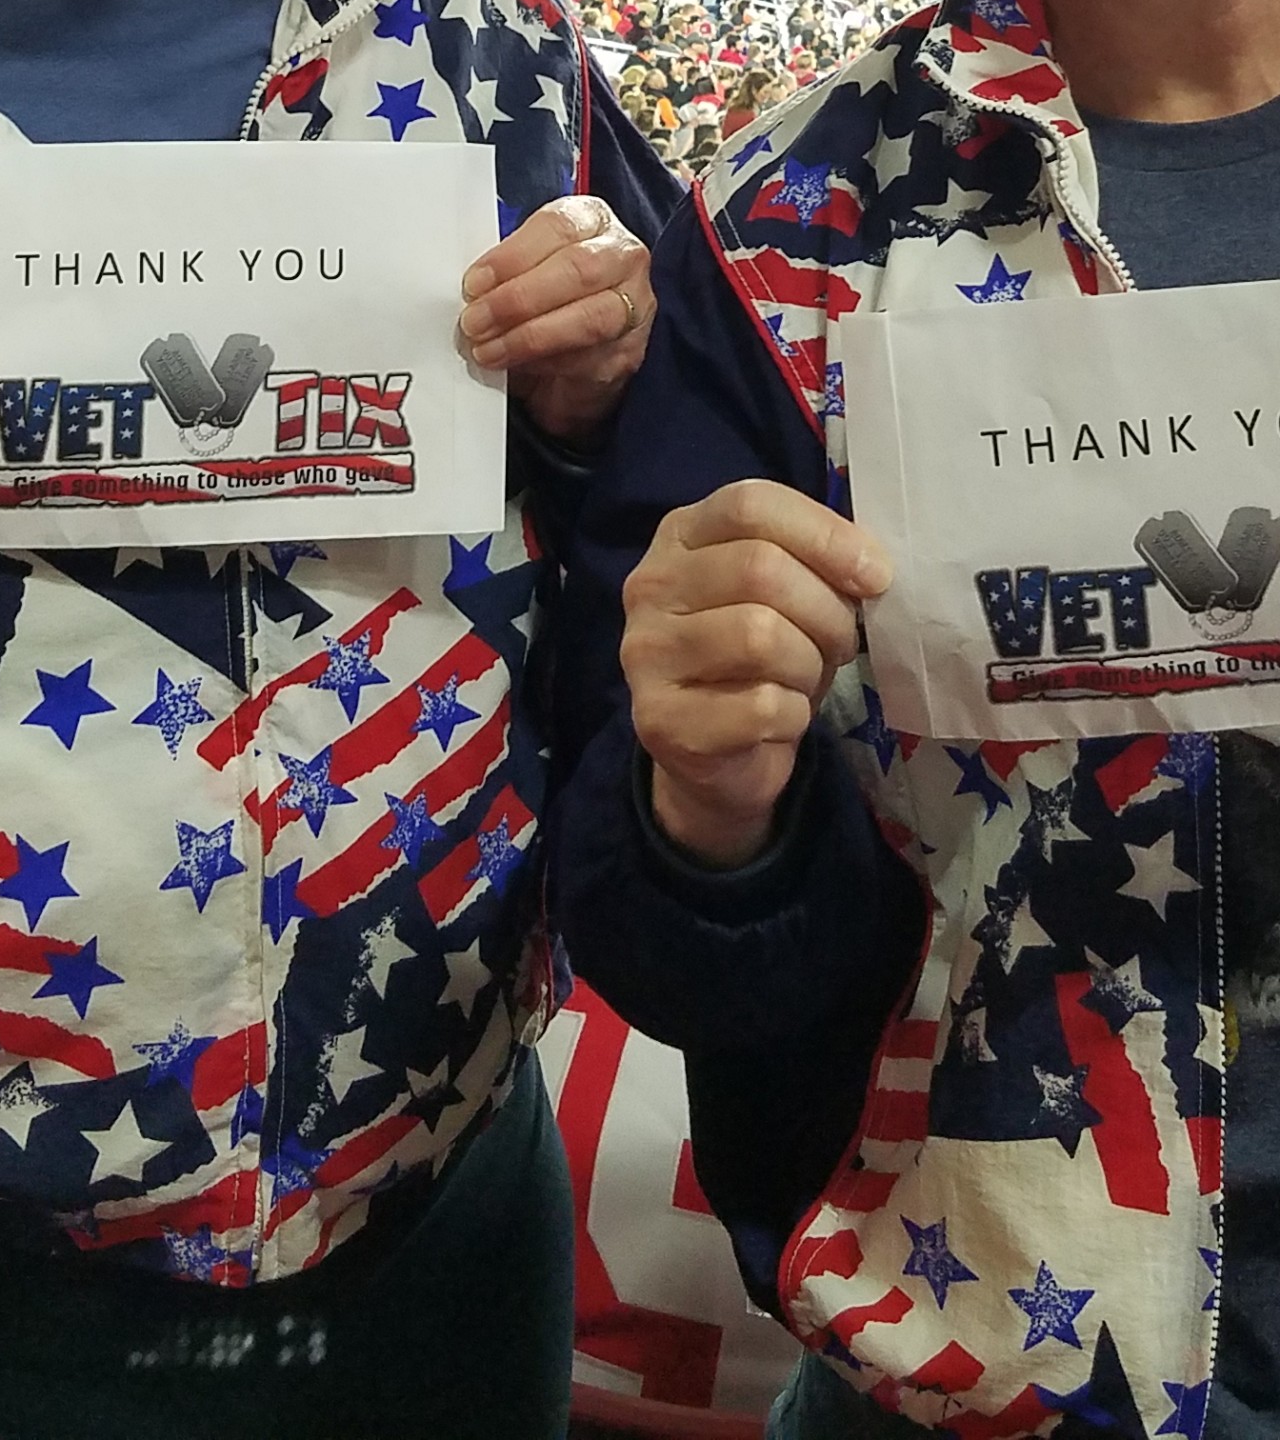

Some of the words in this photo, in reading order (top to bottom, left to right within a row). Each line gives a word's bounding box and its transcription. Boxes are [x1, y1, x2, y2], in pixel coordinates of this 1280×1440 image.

[15, 250, 205, 287] THANK
[238, 248, 346, 282] YOU
[265, 371, 412, 452] TIX
[980, 413, 1199, 468] THANK
[13, 476, 64, 496] Give
[71, 471, 189, 495] something
[197, 472, 218, 489] to
[227, 468, 285, 488] those
[294, 465, 337, 485] who
[345, 465, 394, 486] gave
[975, 566, 1156, 659] VET
[1075, 656, 1207, 685] something
[1217, 656, 1240, 673] to
